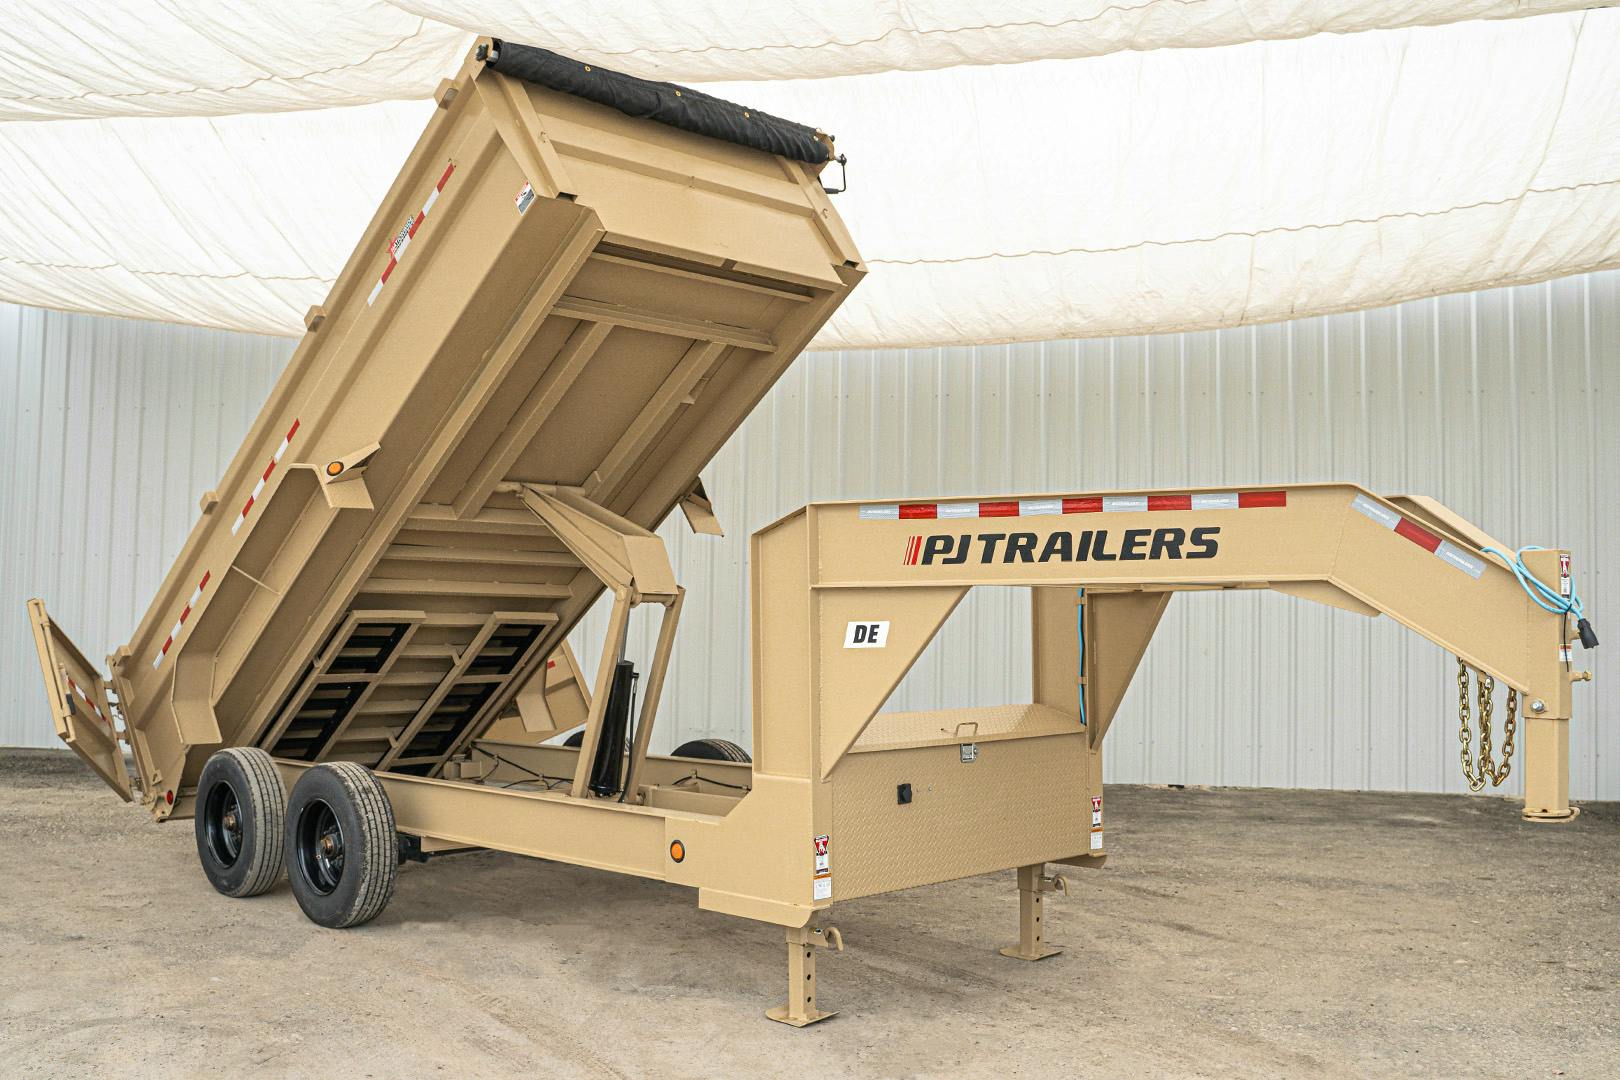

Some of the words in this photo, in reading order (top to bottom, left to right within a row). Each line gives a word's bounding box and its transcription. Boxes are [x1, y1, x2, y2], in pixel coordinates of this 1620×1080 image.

[922, 534, 971, 565] PJ
[978, 527, 1221, 563] TRAILERS
[853, 624, 880, 643] DE
